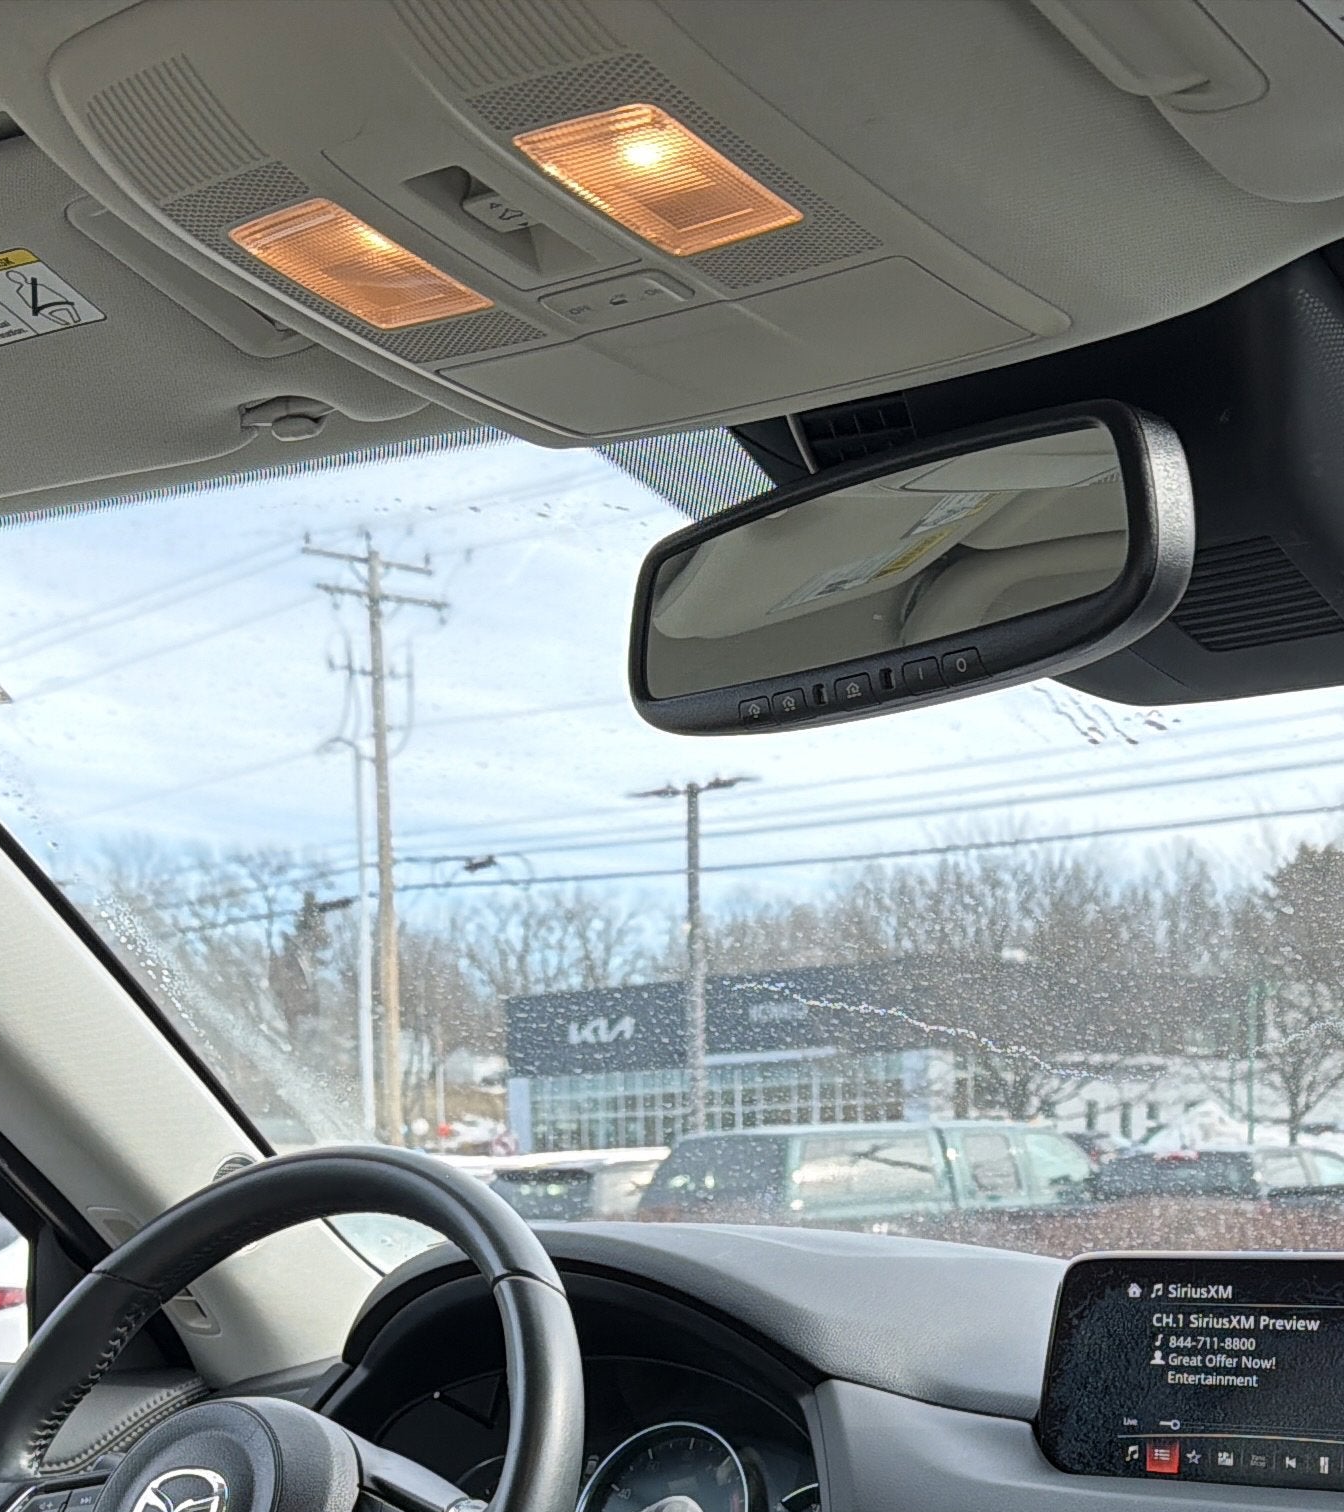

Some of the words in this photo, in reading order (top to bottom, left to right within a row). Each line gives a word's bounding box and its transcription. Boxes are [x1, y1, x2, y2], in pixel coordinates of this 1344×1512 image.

[1167, 1283, 1232, 1299] SiriusXM
[1152, 1313, 1184, 1328] CH.1
[1189, 1313, 1255, 1330] SiriusXM
[1259, 1315, 1320, 1331] Preview
[1168, 1335, 1256, 1351] 844-711-8800
[1168, 1353, 1203, 1367] Great
[1205, 1354, 1238, 1368] Offer
[1241, 1355, 1276, 1370] Now!
[1167, 1371, 1259, 1388] Entertainment
